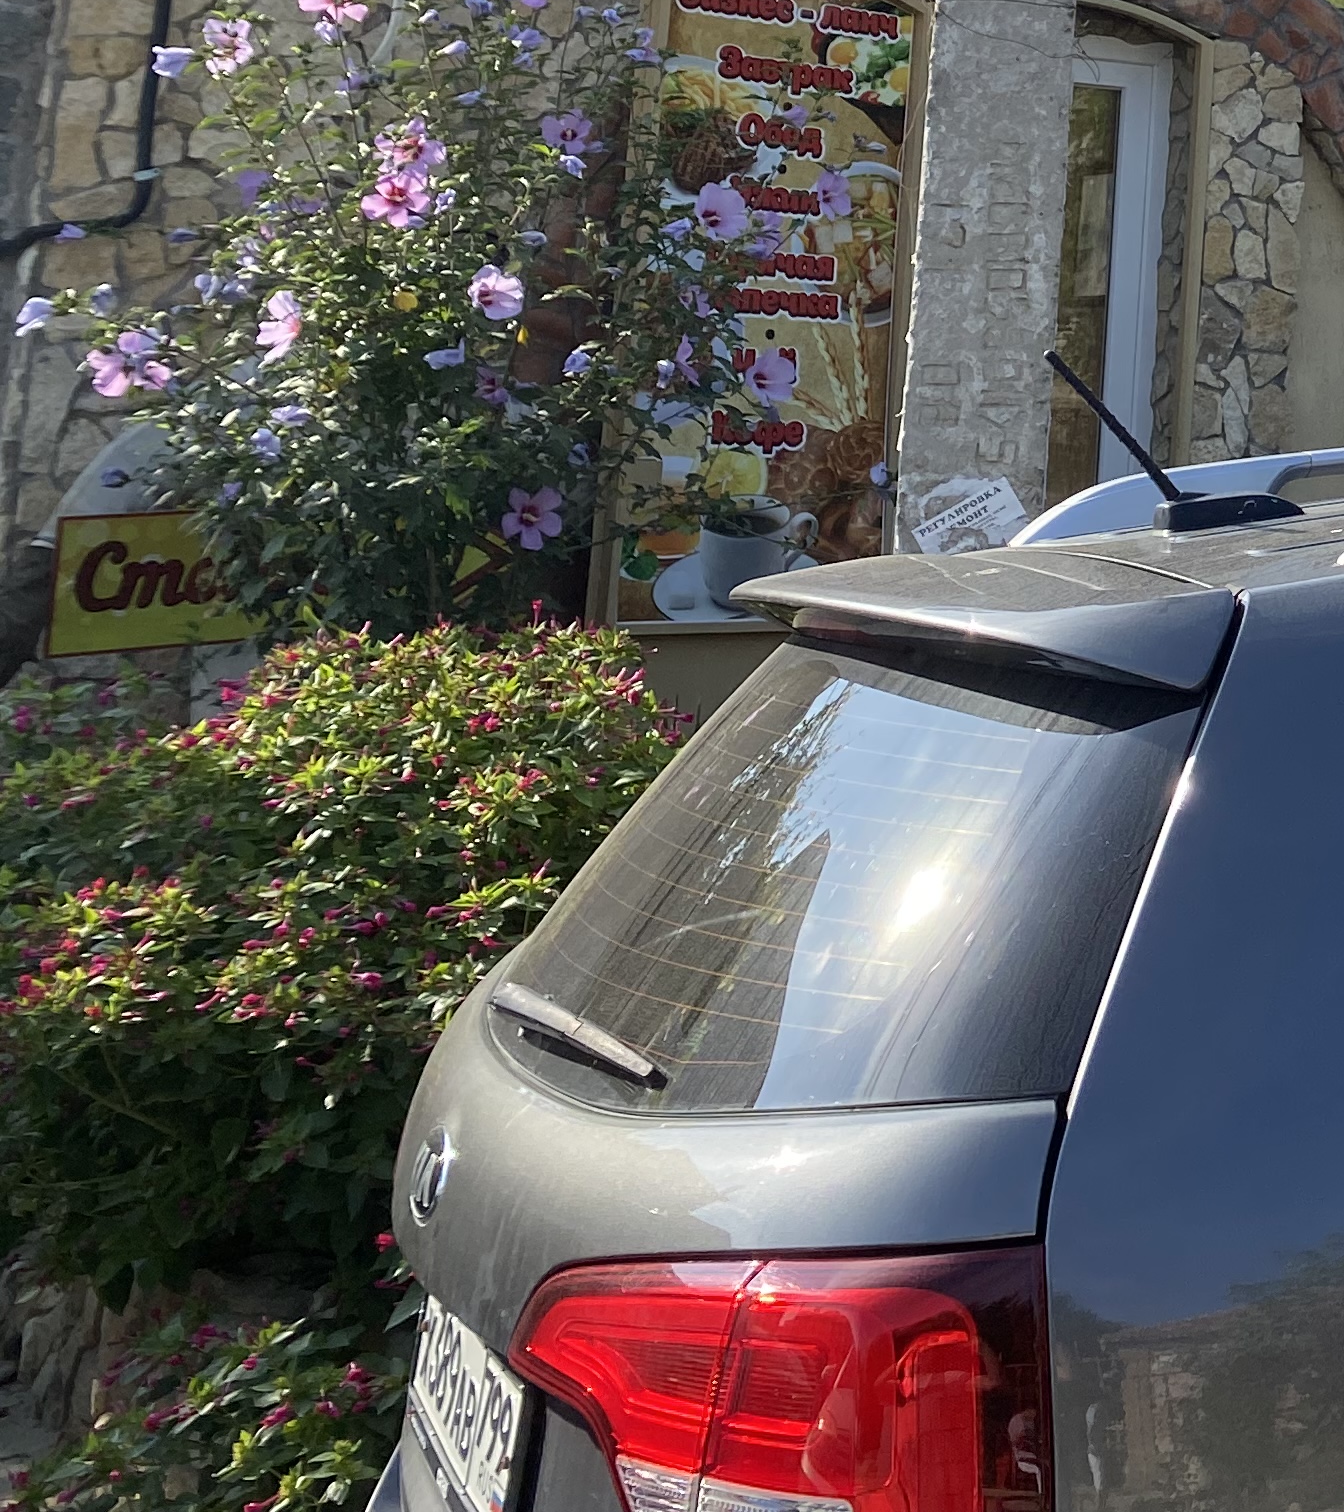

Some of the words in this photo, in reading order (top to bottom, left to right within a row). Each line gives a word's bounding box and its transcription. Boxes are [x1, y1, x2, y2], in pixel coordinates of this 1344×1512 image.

[820, 5, 898, 39] ланч
[718, 45, 854, 95] Завтрак
[948, 505, 989, 531] ЕМОНТ
